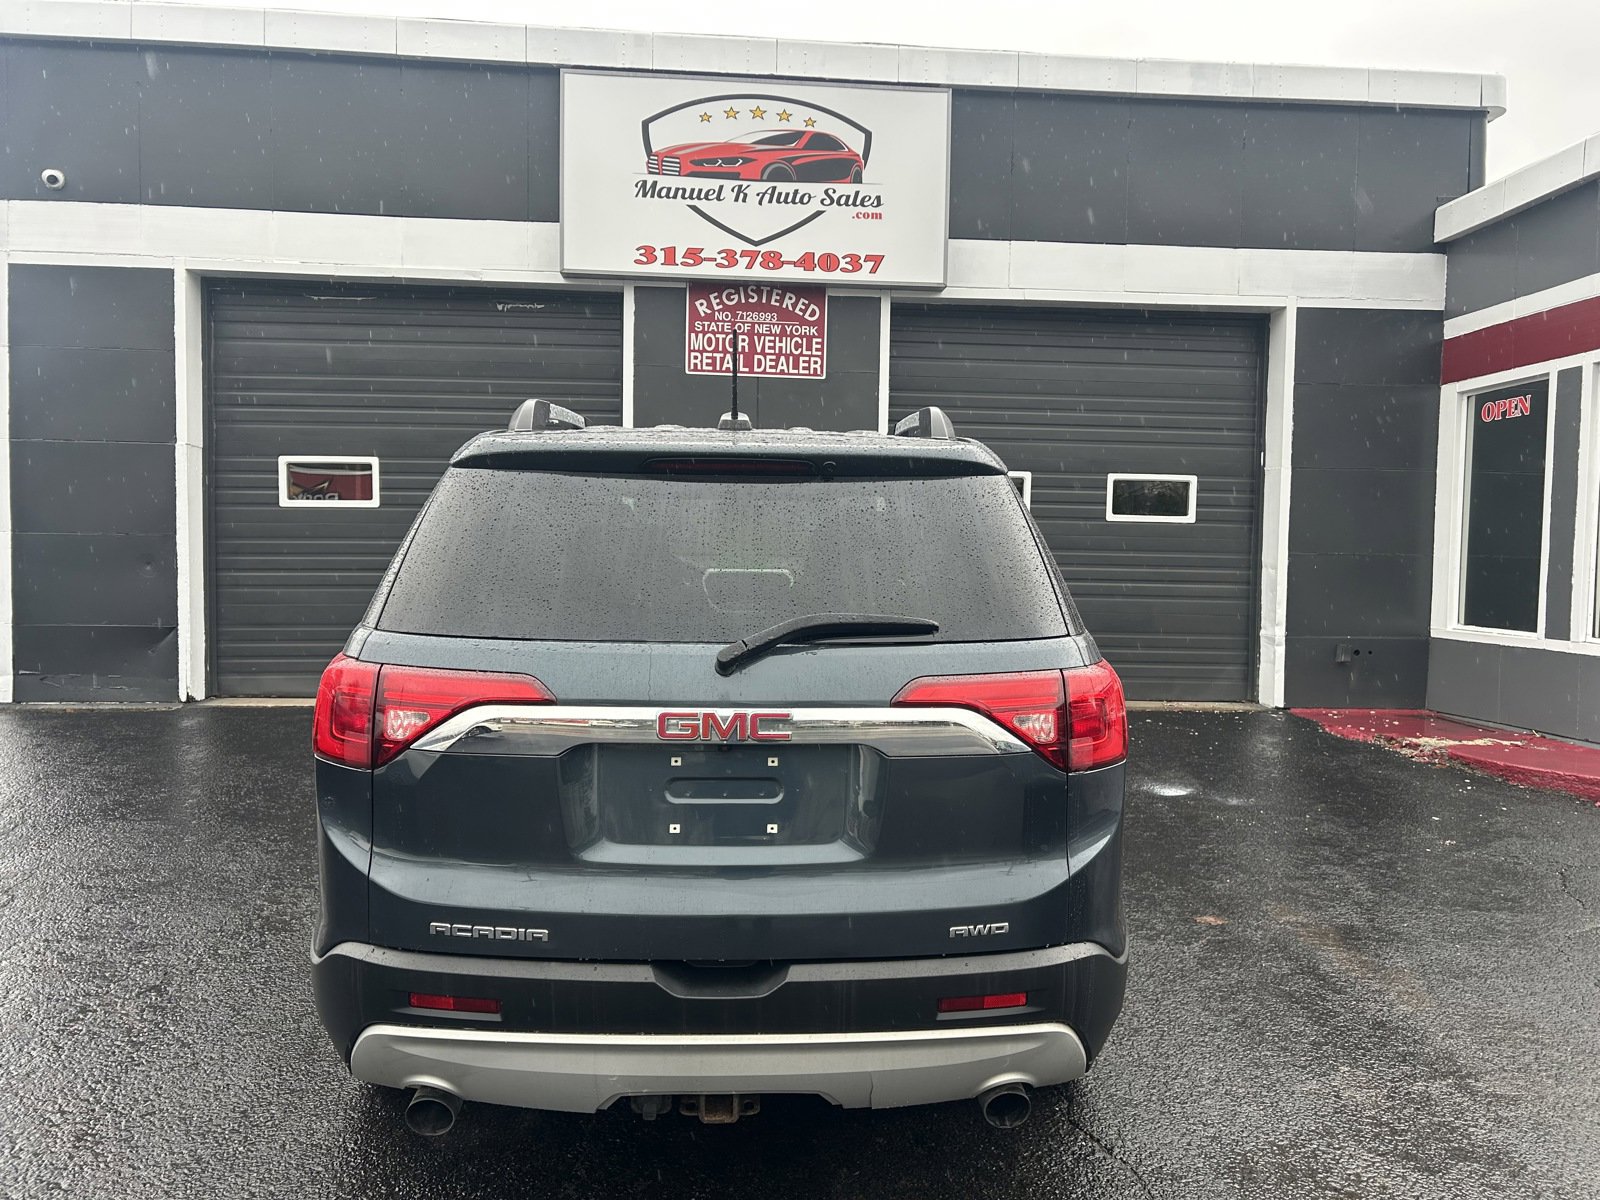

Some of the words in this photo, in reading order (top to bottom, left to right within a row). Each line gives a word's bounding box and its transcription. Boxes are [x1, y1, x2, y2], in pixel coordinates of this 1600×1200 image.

[634, 179, 726, 202] Manuel
[730, 183, 751, 204] K
[755, 186, 816, 207] Auto
[820, 188, 884, 208] Sales
[851, 211, 883, 220] .com
[634, 245, 885, 274] 315-378-4037
[694, 285, 820, 322] REGISTERED
[715, 312, 734, 321] NO.
[736, 311, 778, 322] 7126993
[695, 321, 731, 332] STATE
[735, 324, 751, 333] OF
[755, 324, 781, 334] NEW
[785, 325, 818, 336] YORK
[690, 333, 749, 352] MOTOR
[754, 336, 822, 355] VEHICLE
[754, 354, 822, 375] DEALER
[1481, 395, 1531, 422] OPEN
[656, 710, 793, 742] GMC
[429, 922, 549, 942] ACADIA
[949, 922, 1009, 938] AWD
